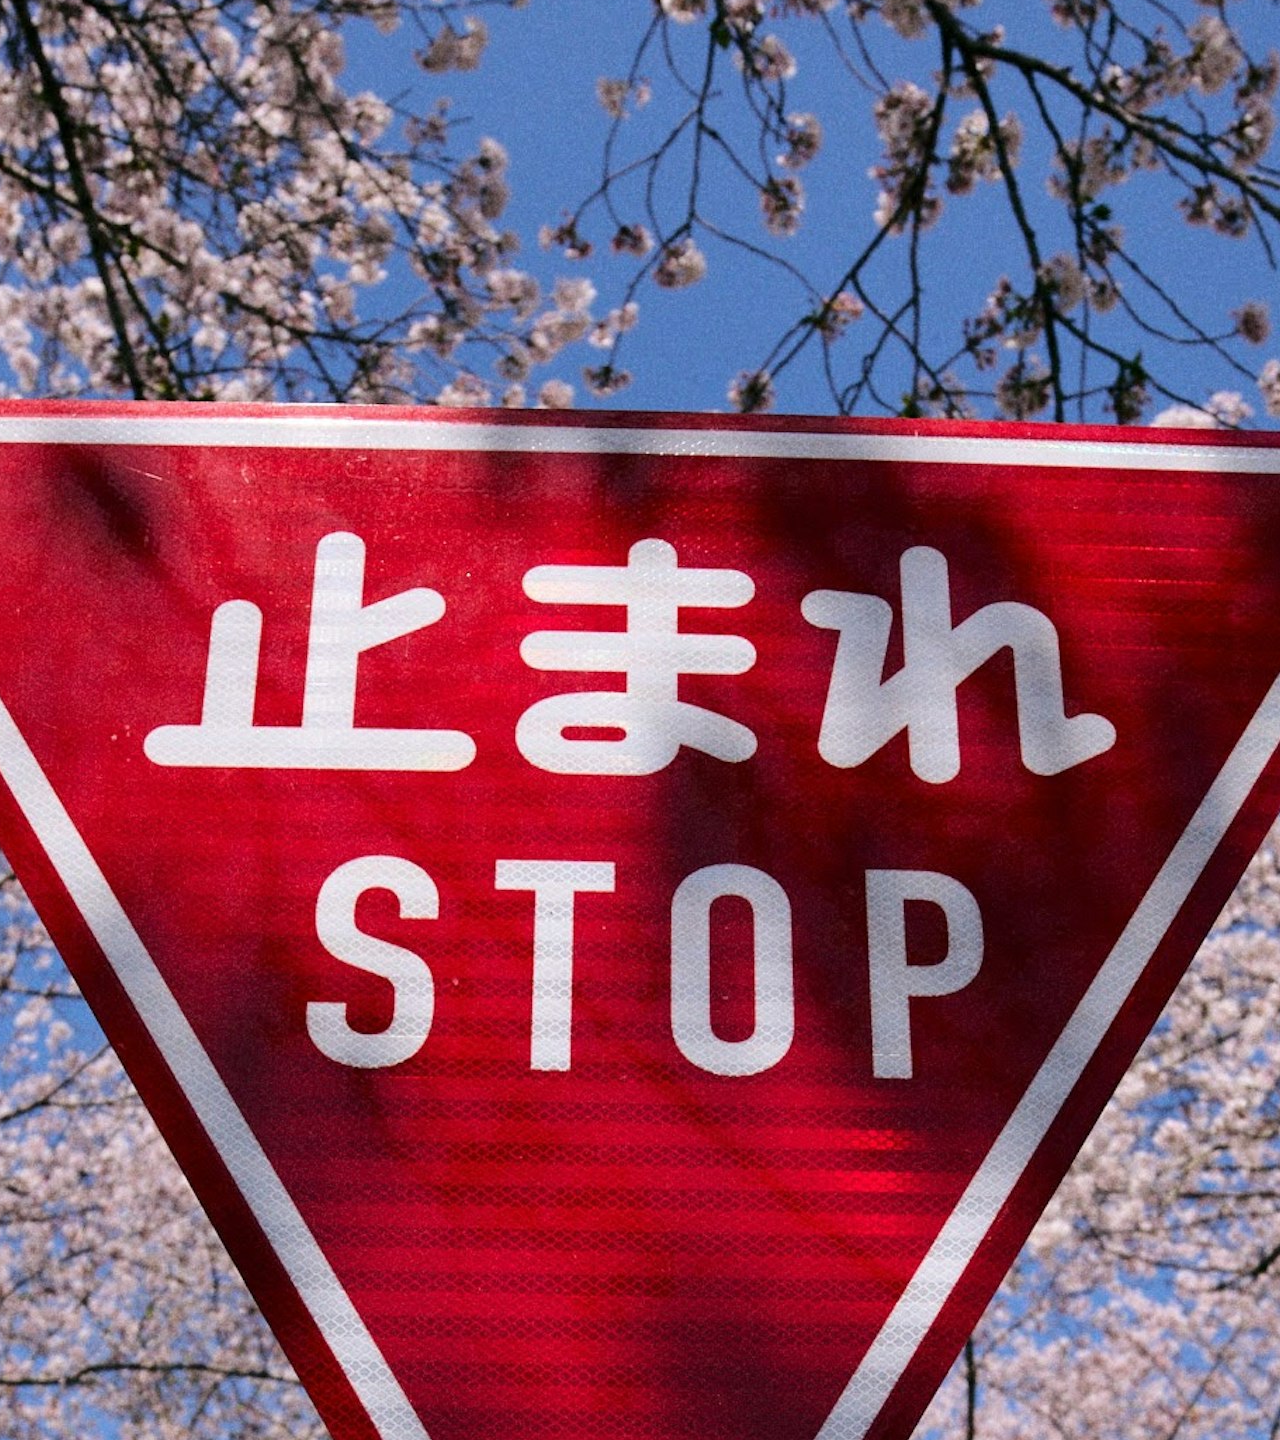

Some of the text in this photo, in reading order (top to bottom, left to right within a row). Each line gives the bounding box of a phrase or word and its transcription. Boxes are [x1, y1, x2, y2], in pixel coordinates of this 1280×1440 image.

[143, 531, 1116, 784] 止まれ
[306, 855, 984, 1079] STOP
